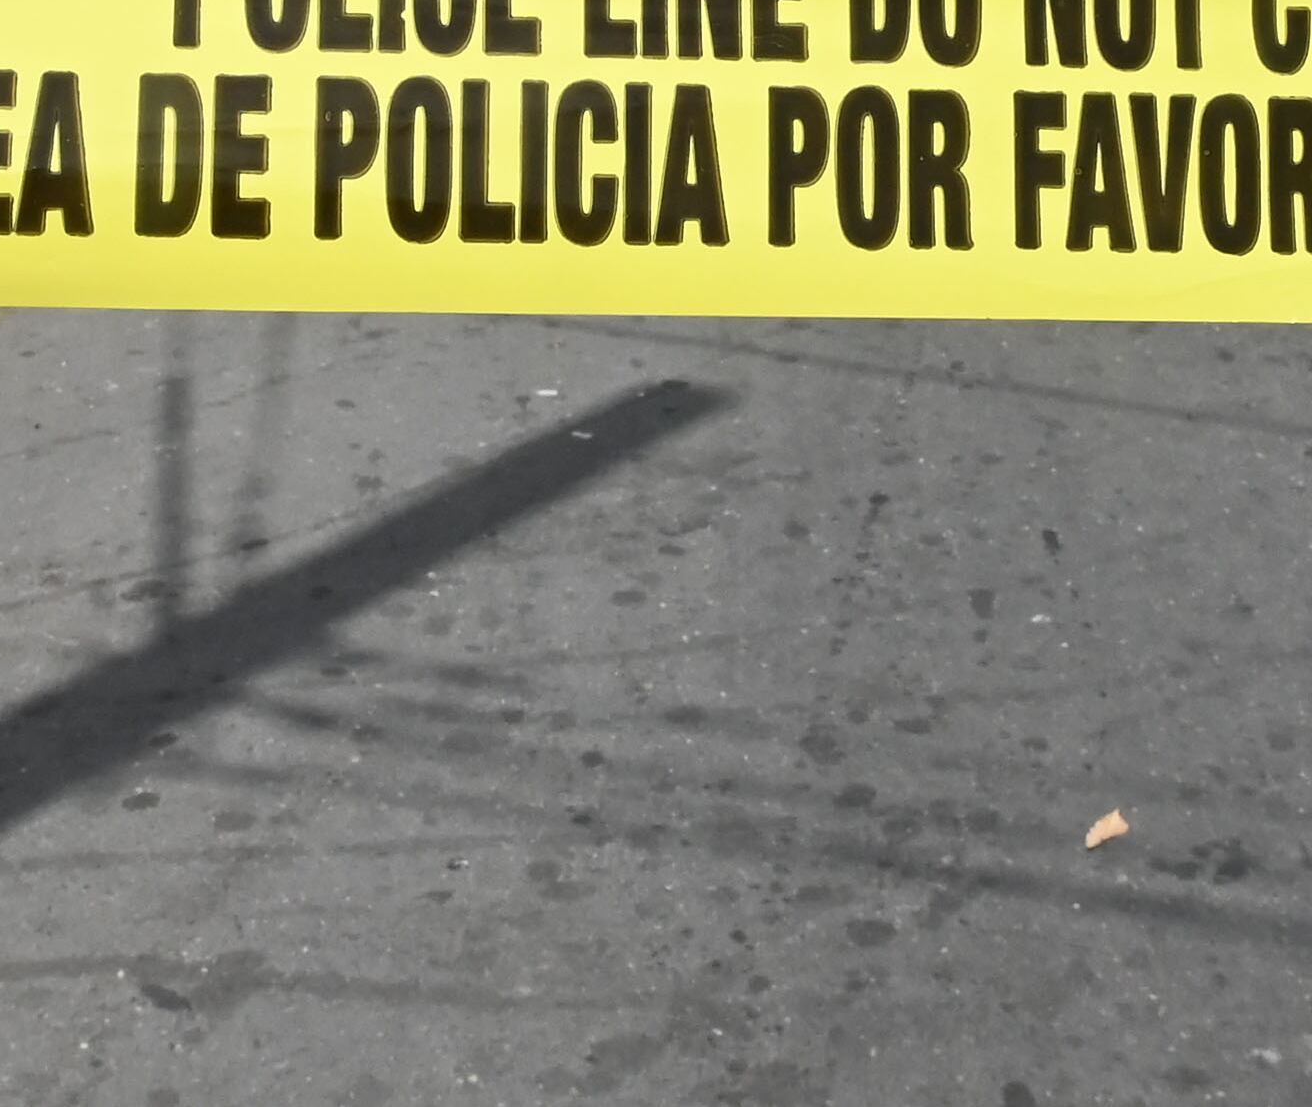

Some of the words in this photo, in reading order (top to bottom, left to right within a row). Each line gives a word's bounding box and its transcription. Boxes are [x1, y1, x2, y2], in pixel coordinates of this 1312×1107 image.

[133, 75, 272, 240] DE
[313, 77, 731, 248] POLICIA
[767, 86, 975, 252] POR
